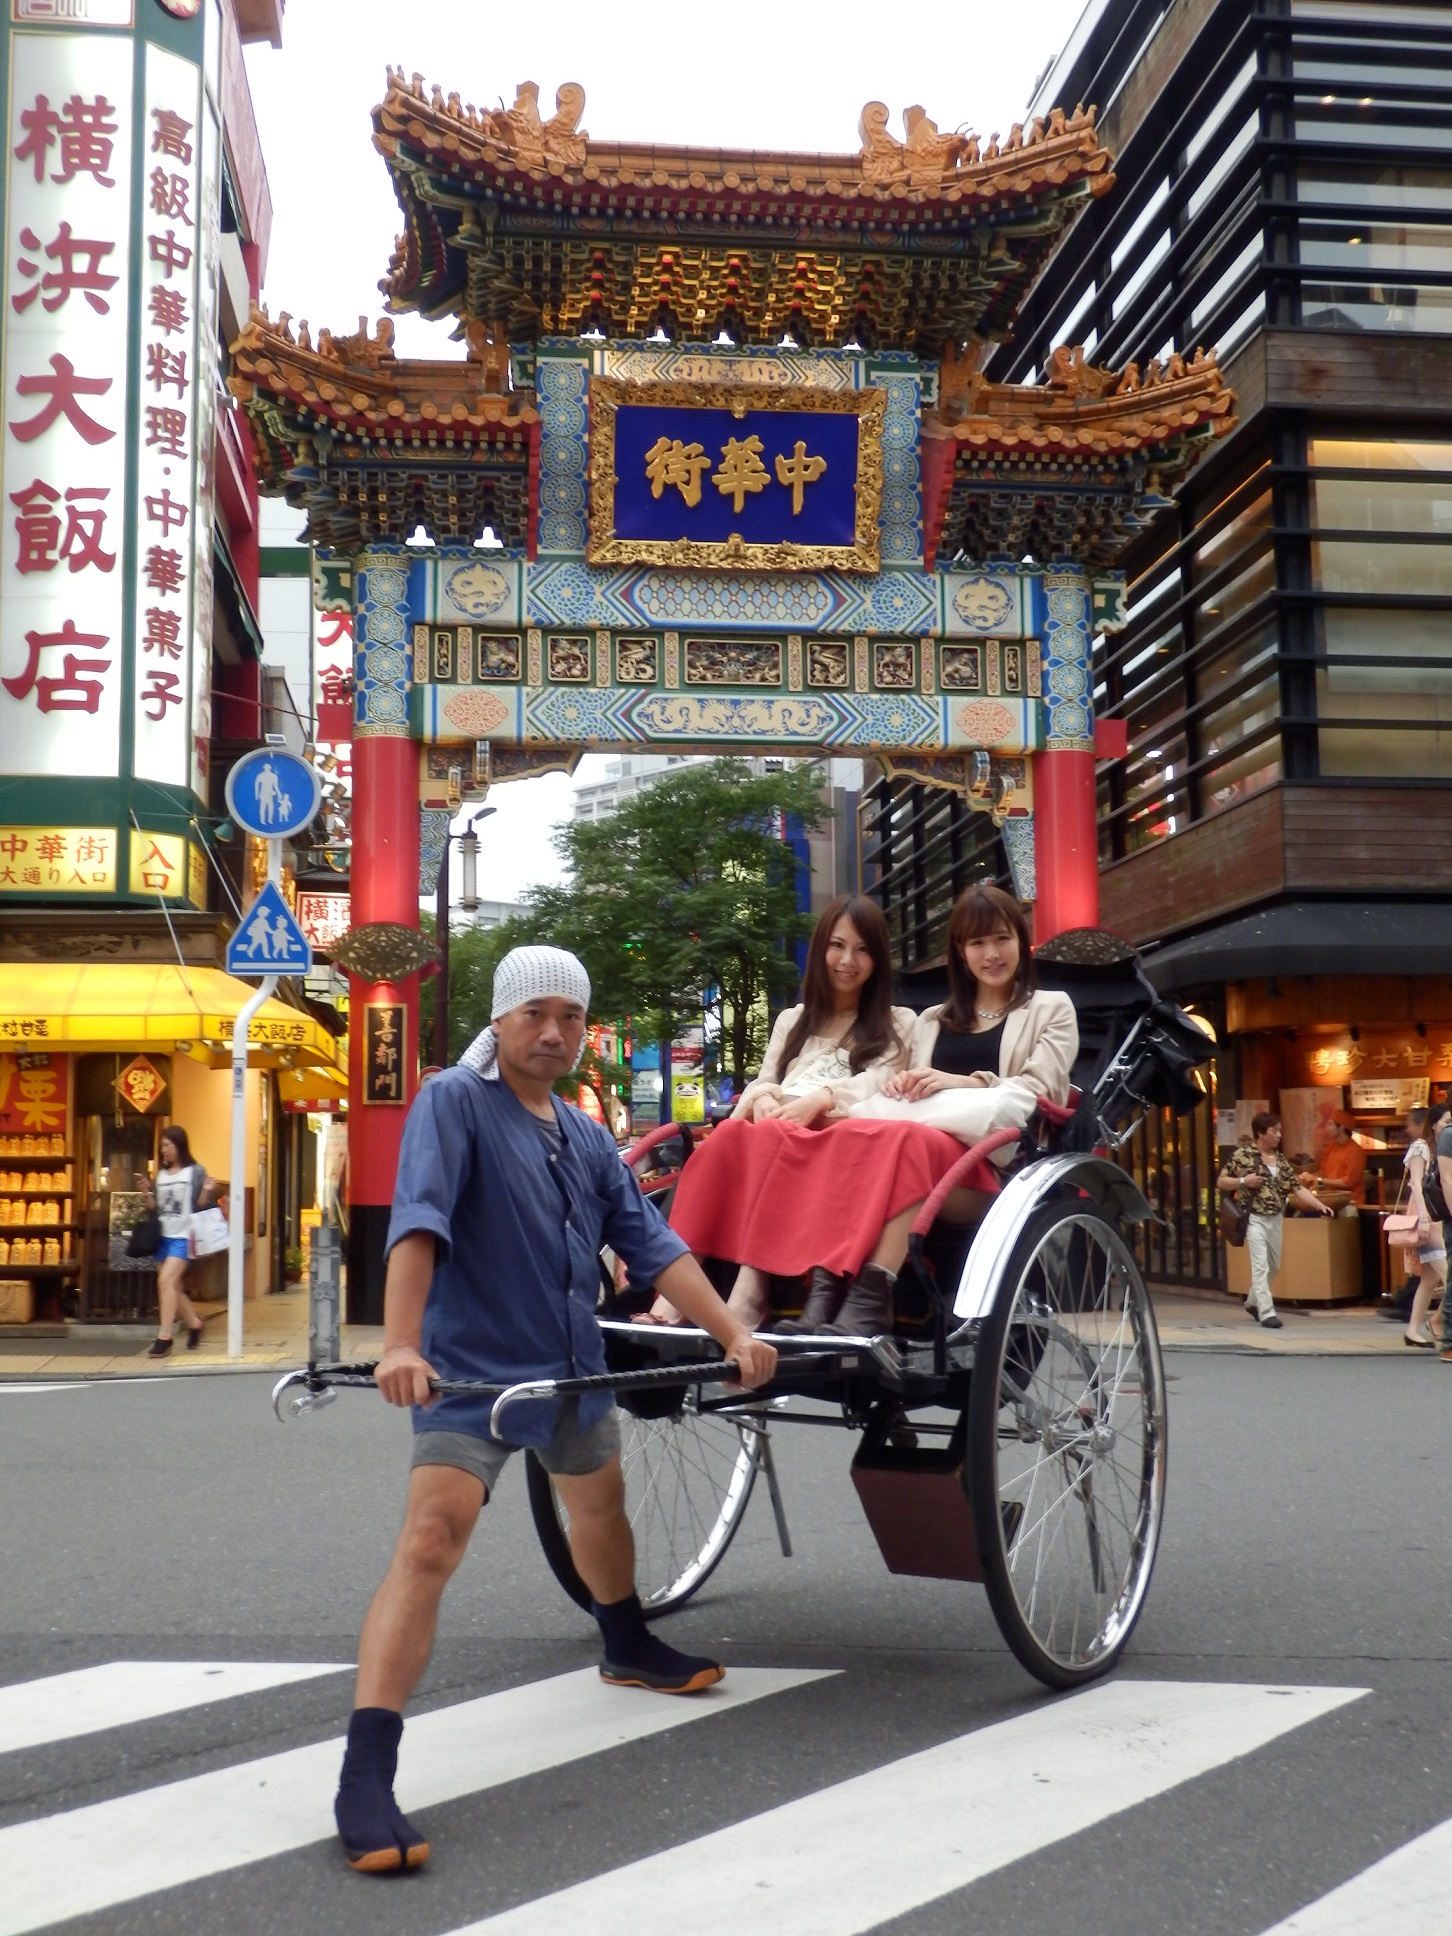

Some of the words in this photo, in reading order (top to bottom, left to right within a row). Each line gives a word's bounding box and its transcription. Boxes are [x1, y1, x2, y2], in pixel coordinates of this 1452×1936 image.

[1, 93, 119, 715] 横浜大飯店
[0, 833, 109, 864] 中華街
[139, 840, 175, 890] 入口
[218, 1019, 306, 1042] 横大飯店
